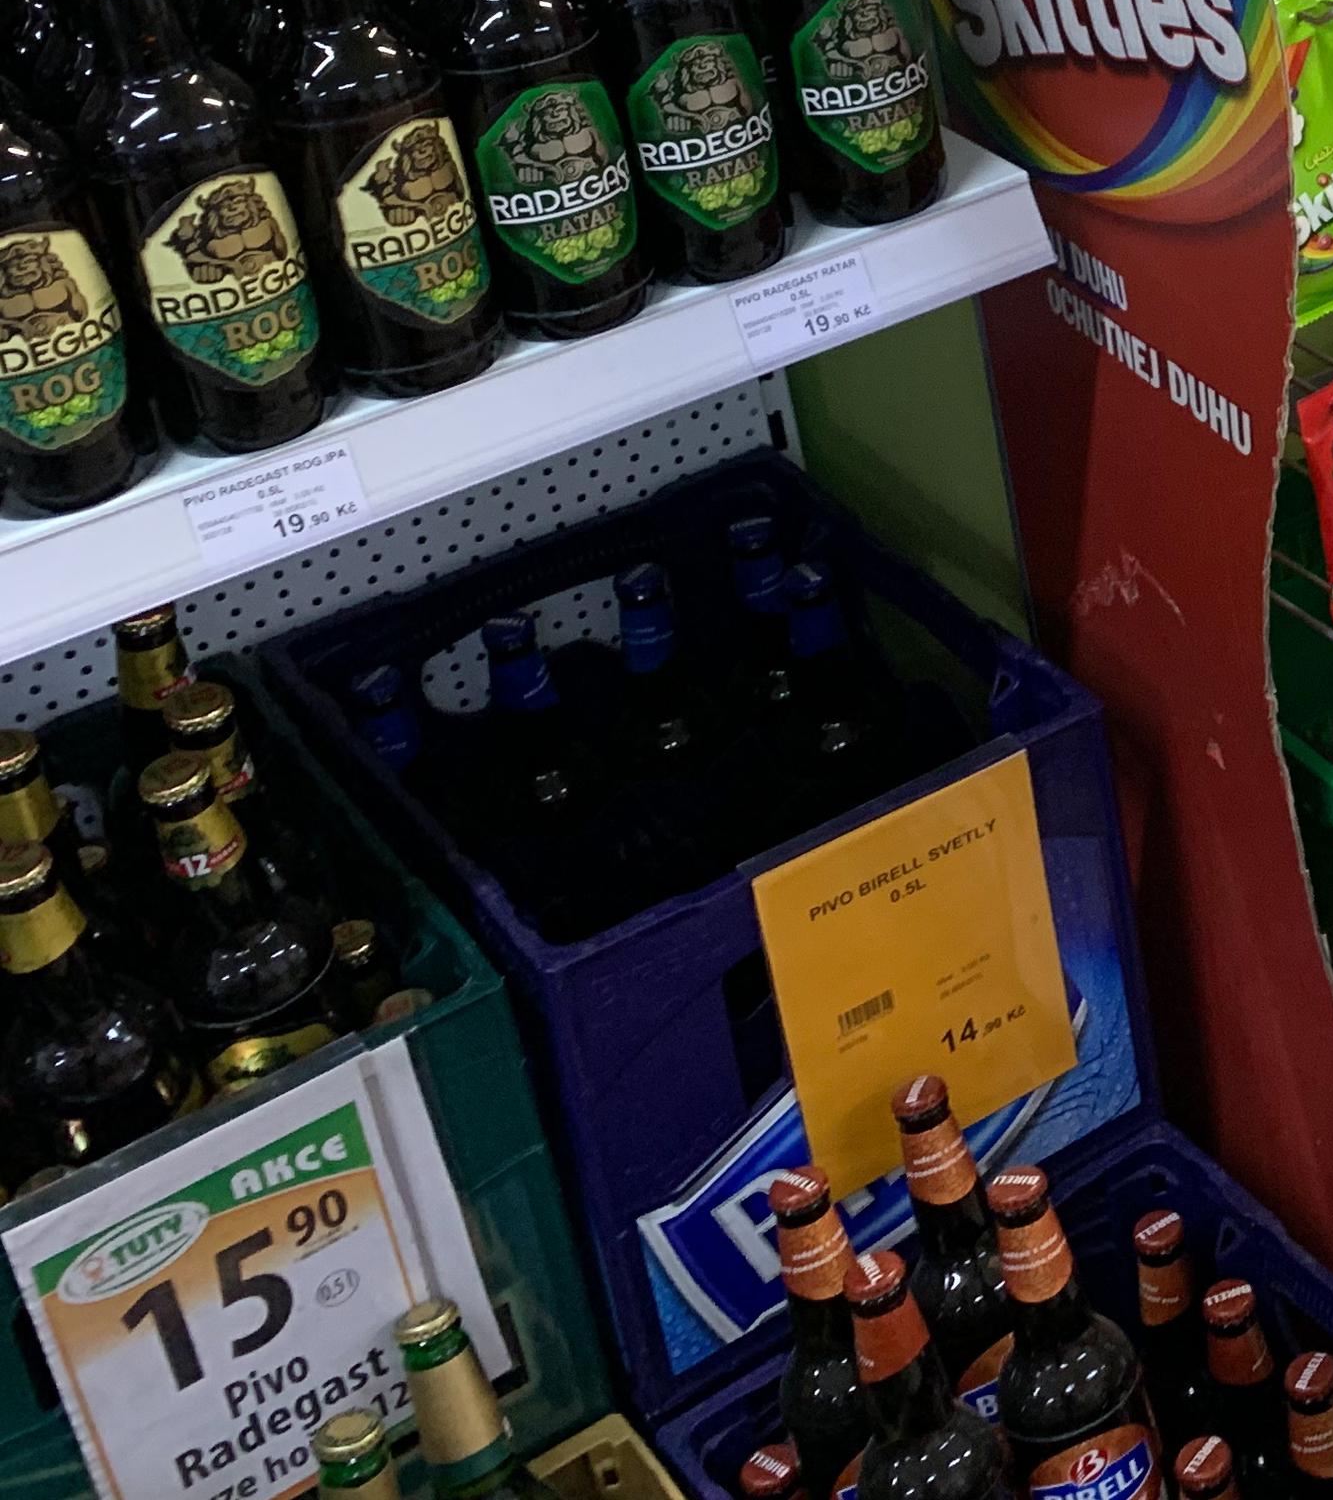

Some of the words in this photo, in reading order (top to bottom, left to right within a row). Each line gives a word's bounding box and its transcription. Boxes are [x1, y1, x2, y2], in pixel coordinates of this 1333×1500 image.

[801, 54, 929, 106] RADEGAS
[638, 104, 774, 160] RADEGAS
[847, 101, 920, 132] RATAR
[686, 151, 761, 190] RATAR
[352, 199, 476, 270] RADEGA
[541, 203, 621, 242] RATAR
[155, 252, 307, 324] RADEGA
[734, 293, 761, 308] PIVO
[762, 271, 819, 298] RADEGAST
[821, 257, 857, 277] RATAR
[1067, 238, 1129, 312] DUHU
[221, 298, 303, 352] ROG
[853, 303, 872, 319] Kč
[12, 363, 102, 412] ROG
[1044, 276, 1164, 391] OCHUTNEJ
[1165, 357, 1255, 457] DUHU
[183, 489, 217, 508] PIVO
[218, 465, 290, 497] RADEGAST
[177, 851, 212, 878] 12
[808, 889, 855, 922] PIVO
[857, 856, 925, 898] BIRELL
[927, 818, 998, 863] SVETLY
[229, 1132, 349, 1200] AKCE
[107, 1212, 183, 1267] TUTY
[119, 1226, 295, 1392] 15
[285, 1188, 349, 1247] 90
[223, 1354, 310, 1419] Pivo
[174, 1346, 391, 1490] Radegast
